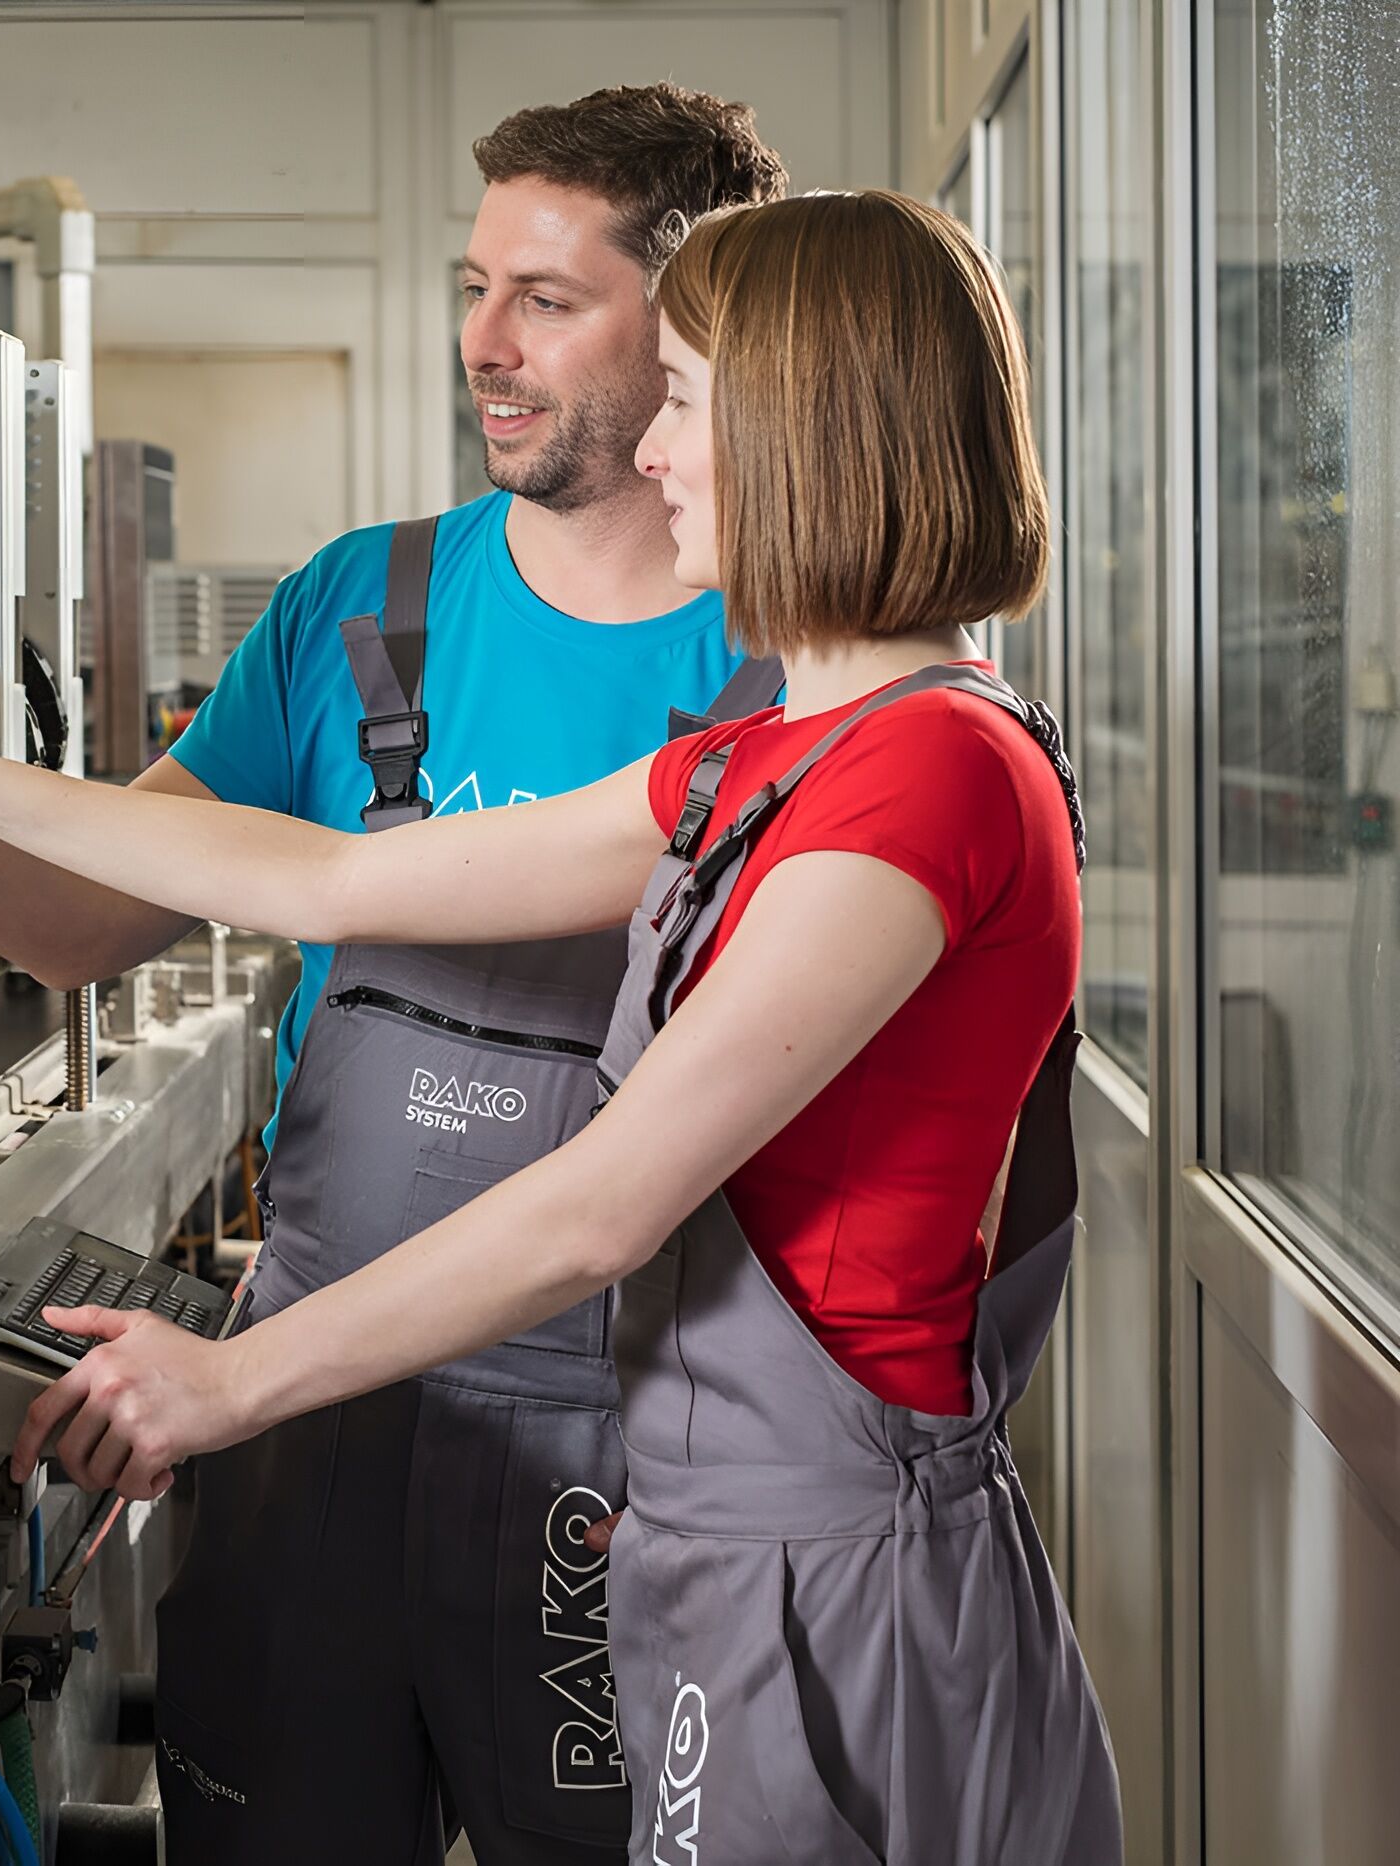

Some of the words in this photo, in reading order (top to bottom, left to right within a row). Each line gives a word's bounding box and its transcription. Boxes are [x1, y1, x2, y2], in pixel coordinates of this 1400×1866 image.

[405, 1104, 467, 1134] SYSTEM
[409, 1068, 526, 1121] RAKO
[539, 1486, 627, 1788] RAKO
